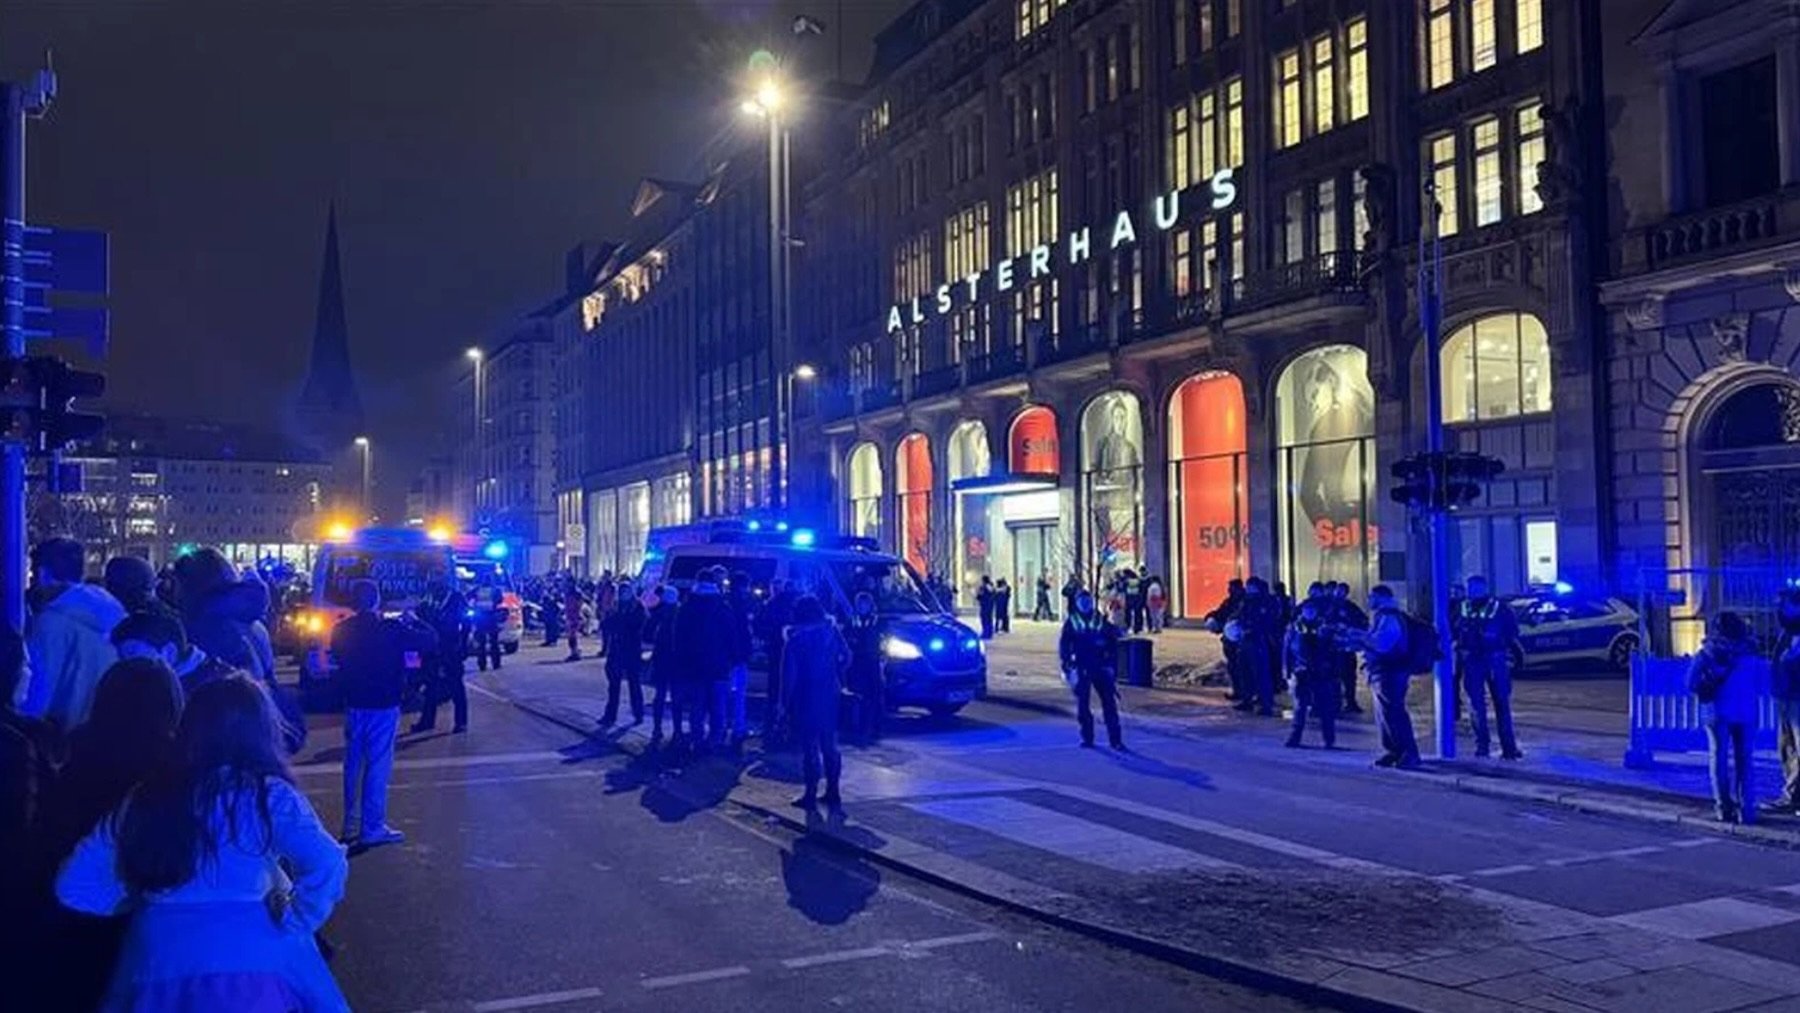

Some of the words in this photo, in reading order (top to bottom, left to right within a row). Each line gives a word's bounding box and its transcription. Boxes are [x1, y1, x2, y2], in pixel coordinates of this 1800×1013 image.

[887, 168, 1236, 333] ALSTERHAUS
[1198, 521, 1250, 550] 50%
[1315, 517, 1377, 547] Sale
